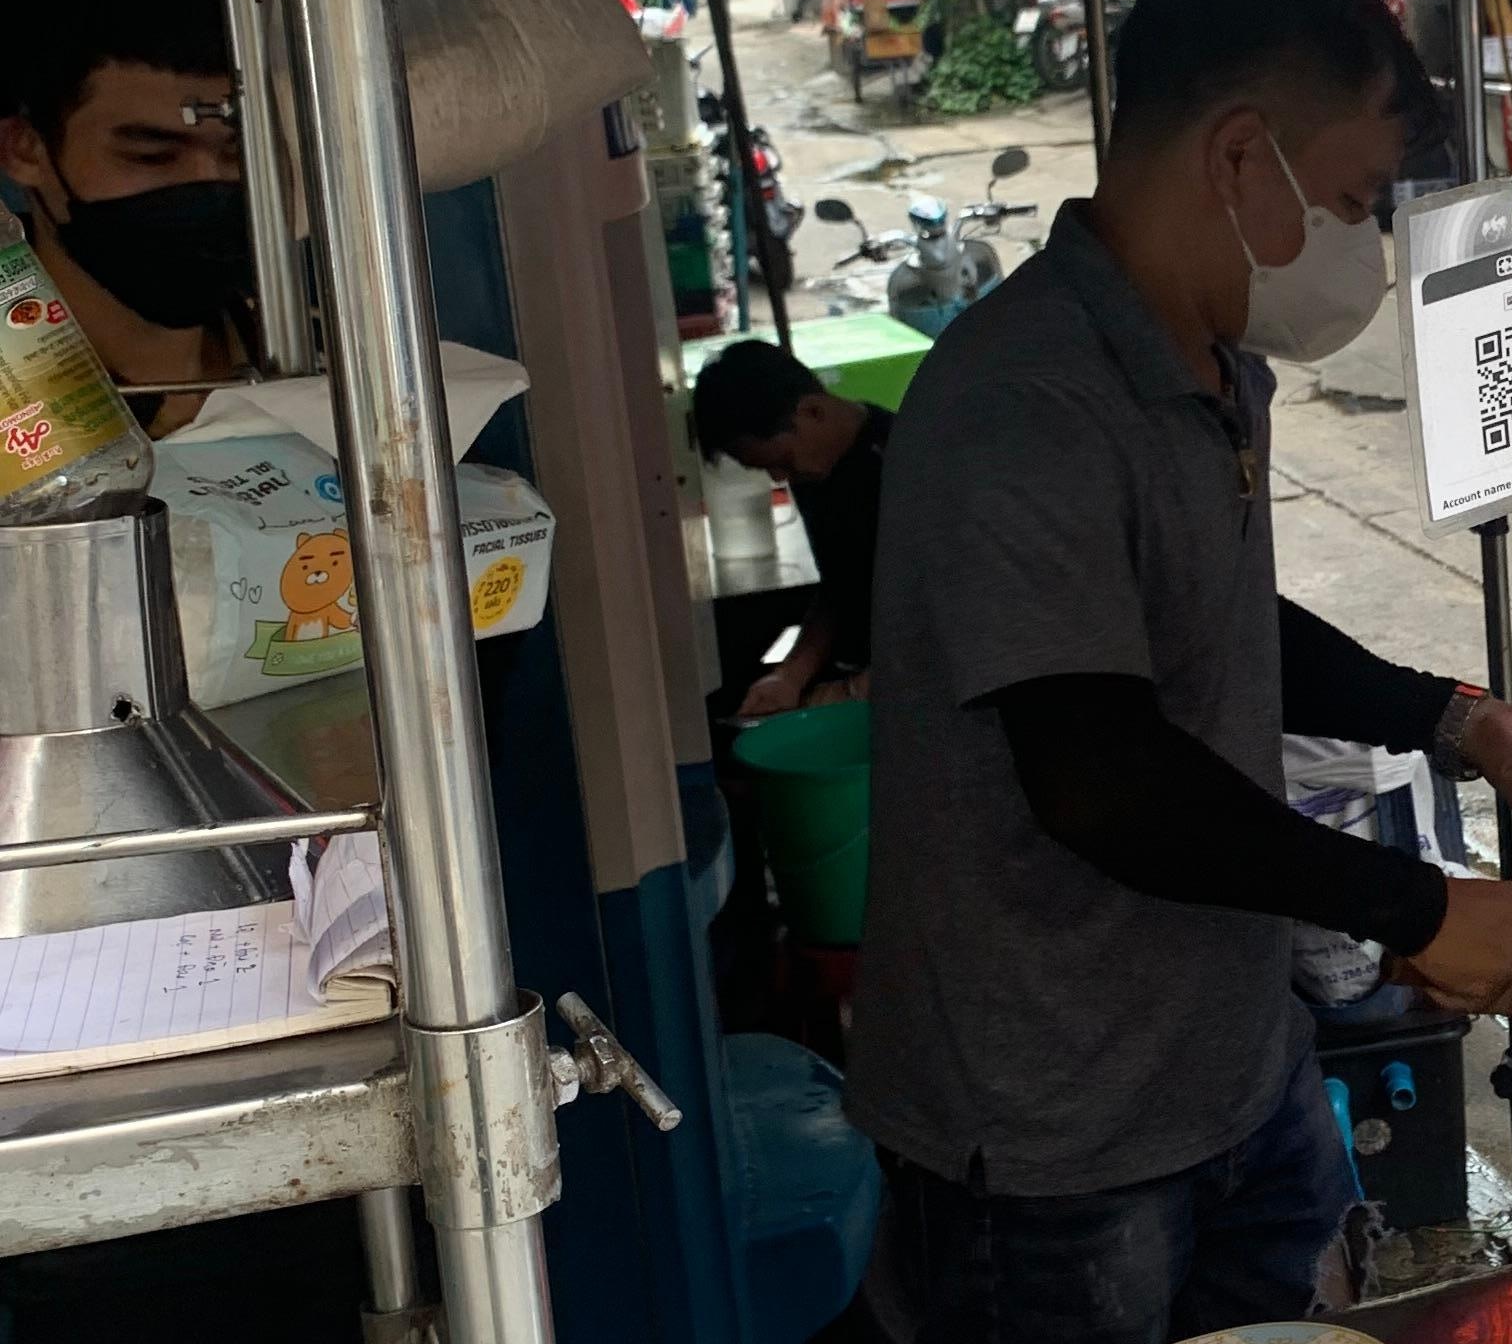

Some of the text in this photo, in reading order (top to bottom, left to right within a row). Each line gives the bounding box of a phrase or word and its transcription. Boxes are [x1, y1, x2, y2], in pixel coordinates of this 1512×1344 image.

[1442, 480, 1512, 511] Account name
[472, 527, 548, 557] FACIAL TISSUES
[484, 577, 512, 597] 220
